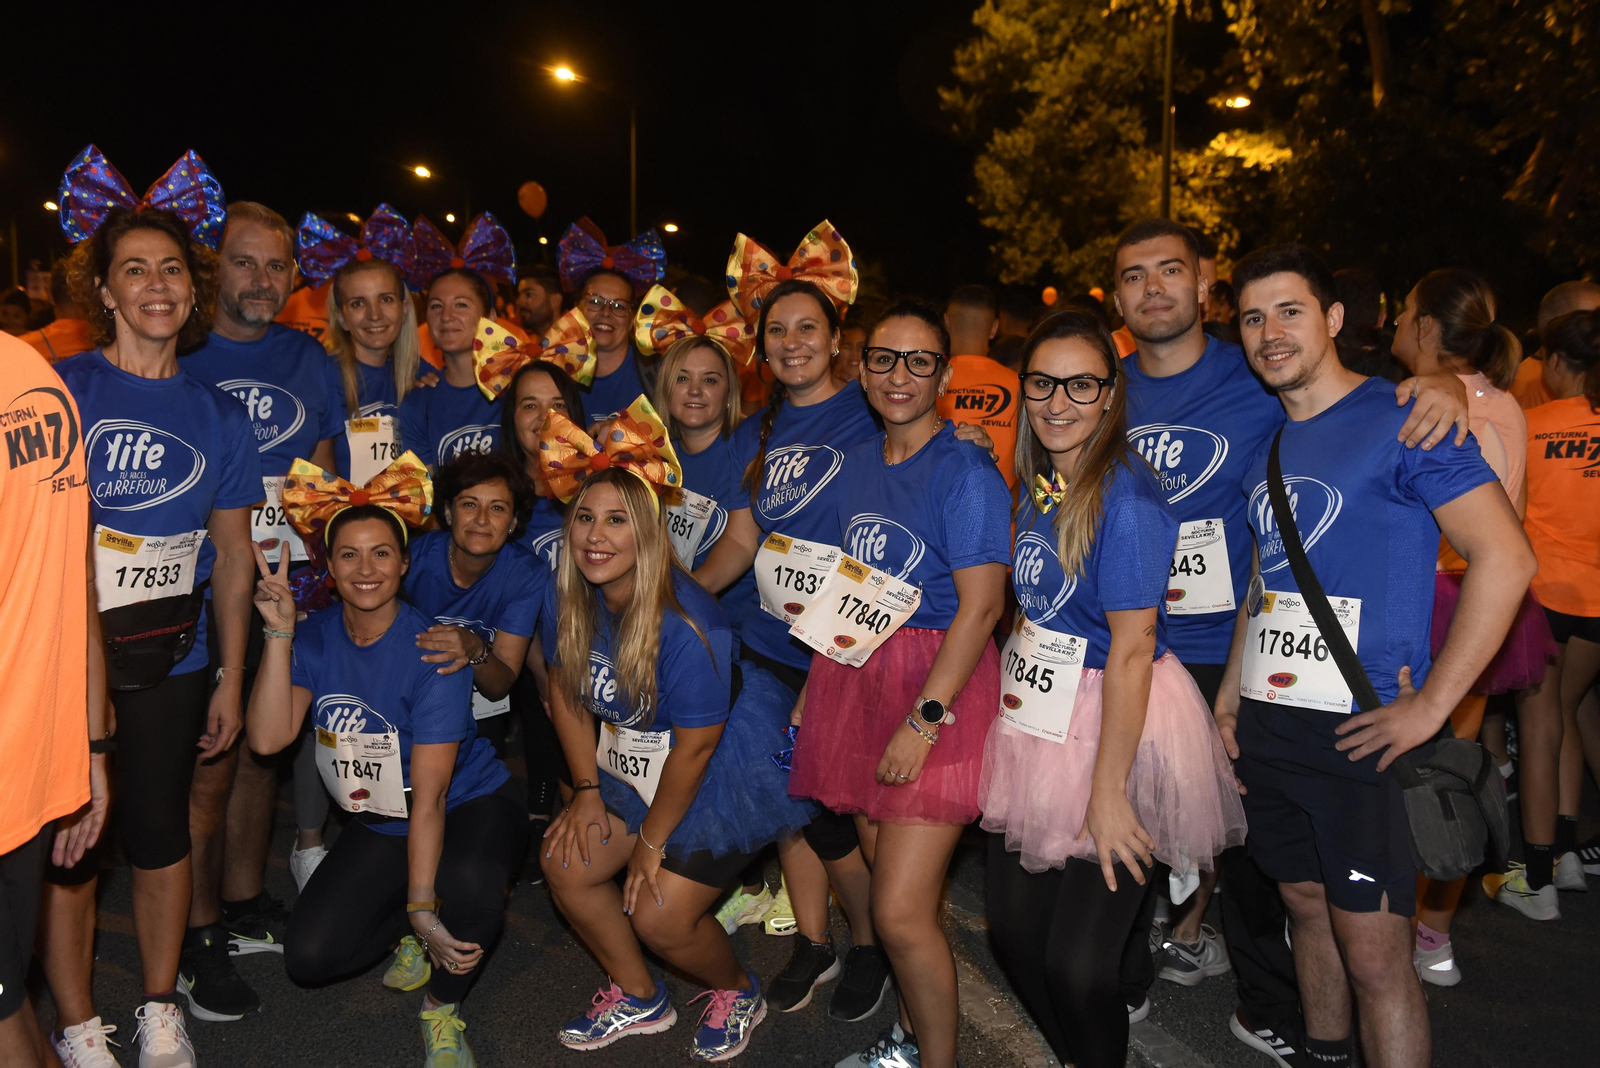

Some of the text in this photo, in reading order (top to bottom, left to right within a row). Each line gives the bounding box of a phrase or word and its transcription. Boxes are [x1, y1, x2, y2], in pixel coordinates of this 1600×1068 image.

[0, 406, 38, 427] CTURNA
[452, 431, 493, 459] life
[1535, 431, 1588, 440] NOCTURNA
[104, 432, 165, 472] life
[370, 442, 402, 460] 178
[1137, 431, 1184, 471] life
[766, 451, 811, 490] life
[96, 478, 167, 498] CARREFOUR
[761, 482, 807, 512] CARREFOUR
[106, 533, 133, 546] Sevilla
[666, 511, 694, 541] 7851
[850, 523, 887, 563] life
[116, 563, 181, 588] 17833
[1015, 545, 1044, 586] life
[1169, 553, 1207, 577] 843
[837, 593, 892, 635] 17840
[1039, 643, 1061, 653] SEVILLA
[1259, 628, 1329, 662] 17846
[590, 665, 618, 703] ife
[1005, 648, 1055, 693] 17845
[1324, 700, 1348, 708] Cruzcampo
[325, 706, 367, 733] life
[331, 759, 382, 781] 17847
[607, 747, 650, 778] 17837
